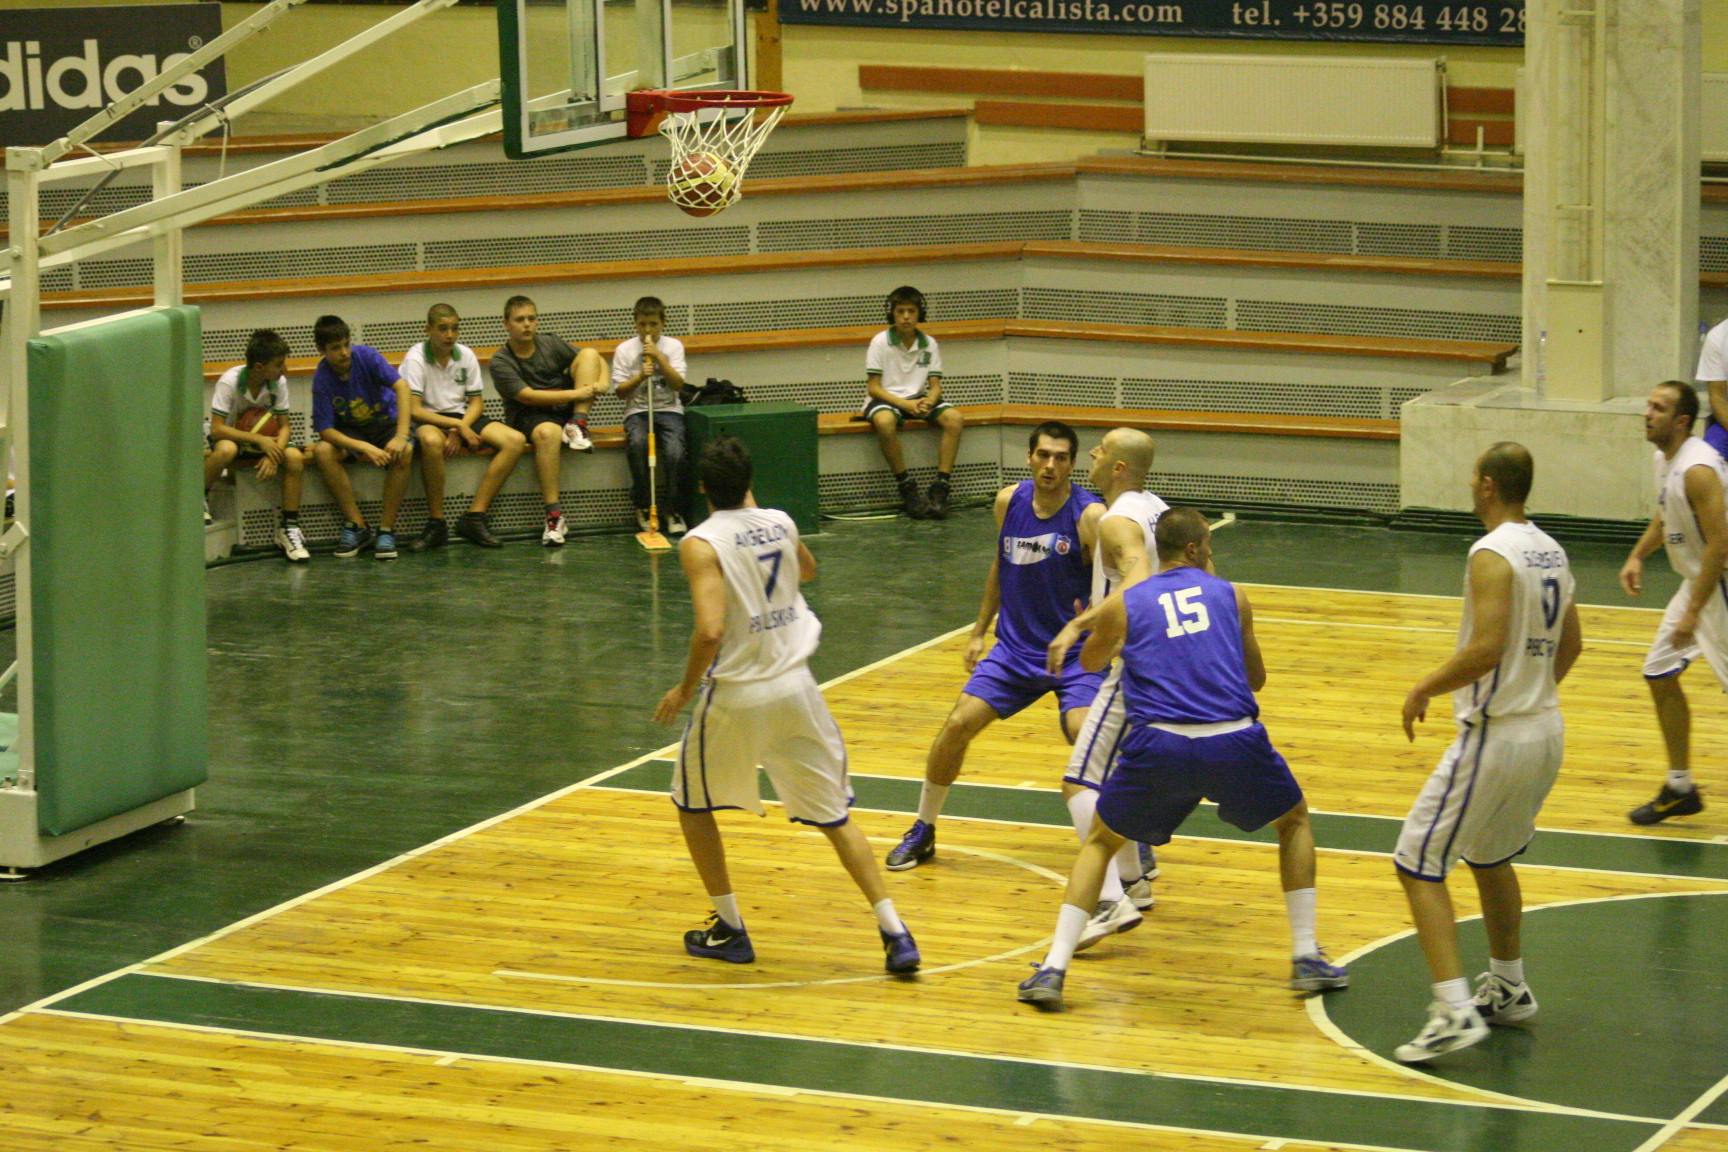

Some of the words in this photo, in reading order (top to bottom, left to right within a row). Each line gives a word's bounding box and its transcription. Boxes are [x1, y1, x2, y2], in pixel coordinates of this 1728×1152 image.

[1231, 0, 1281, 26] tel.
[1292, 2, 1364, 29] +359
[1373, 4, 1426, 30] 884
[1435, 6, 1489, 32] 448
[757, 549, 783, 603] 7
[1157, 585, 1211, 639] 15
